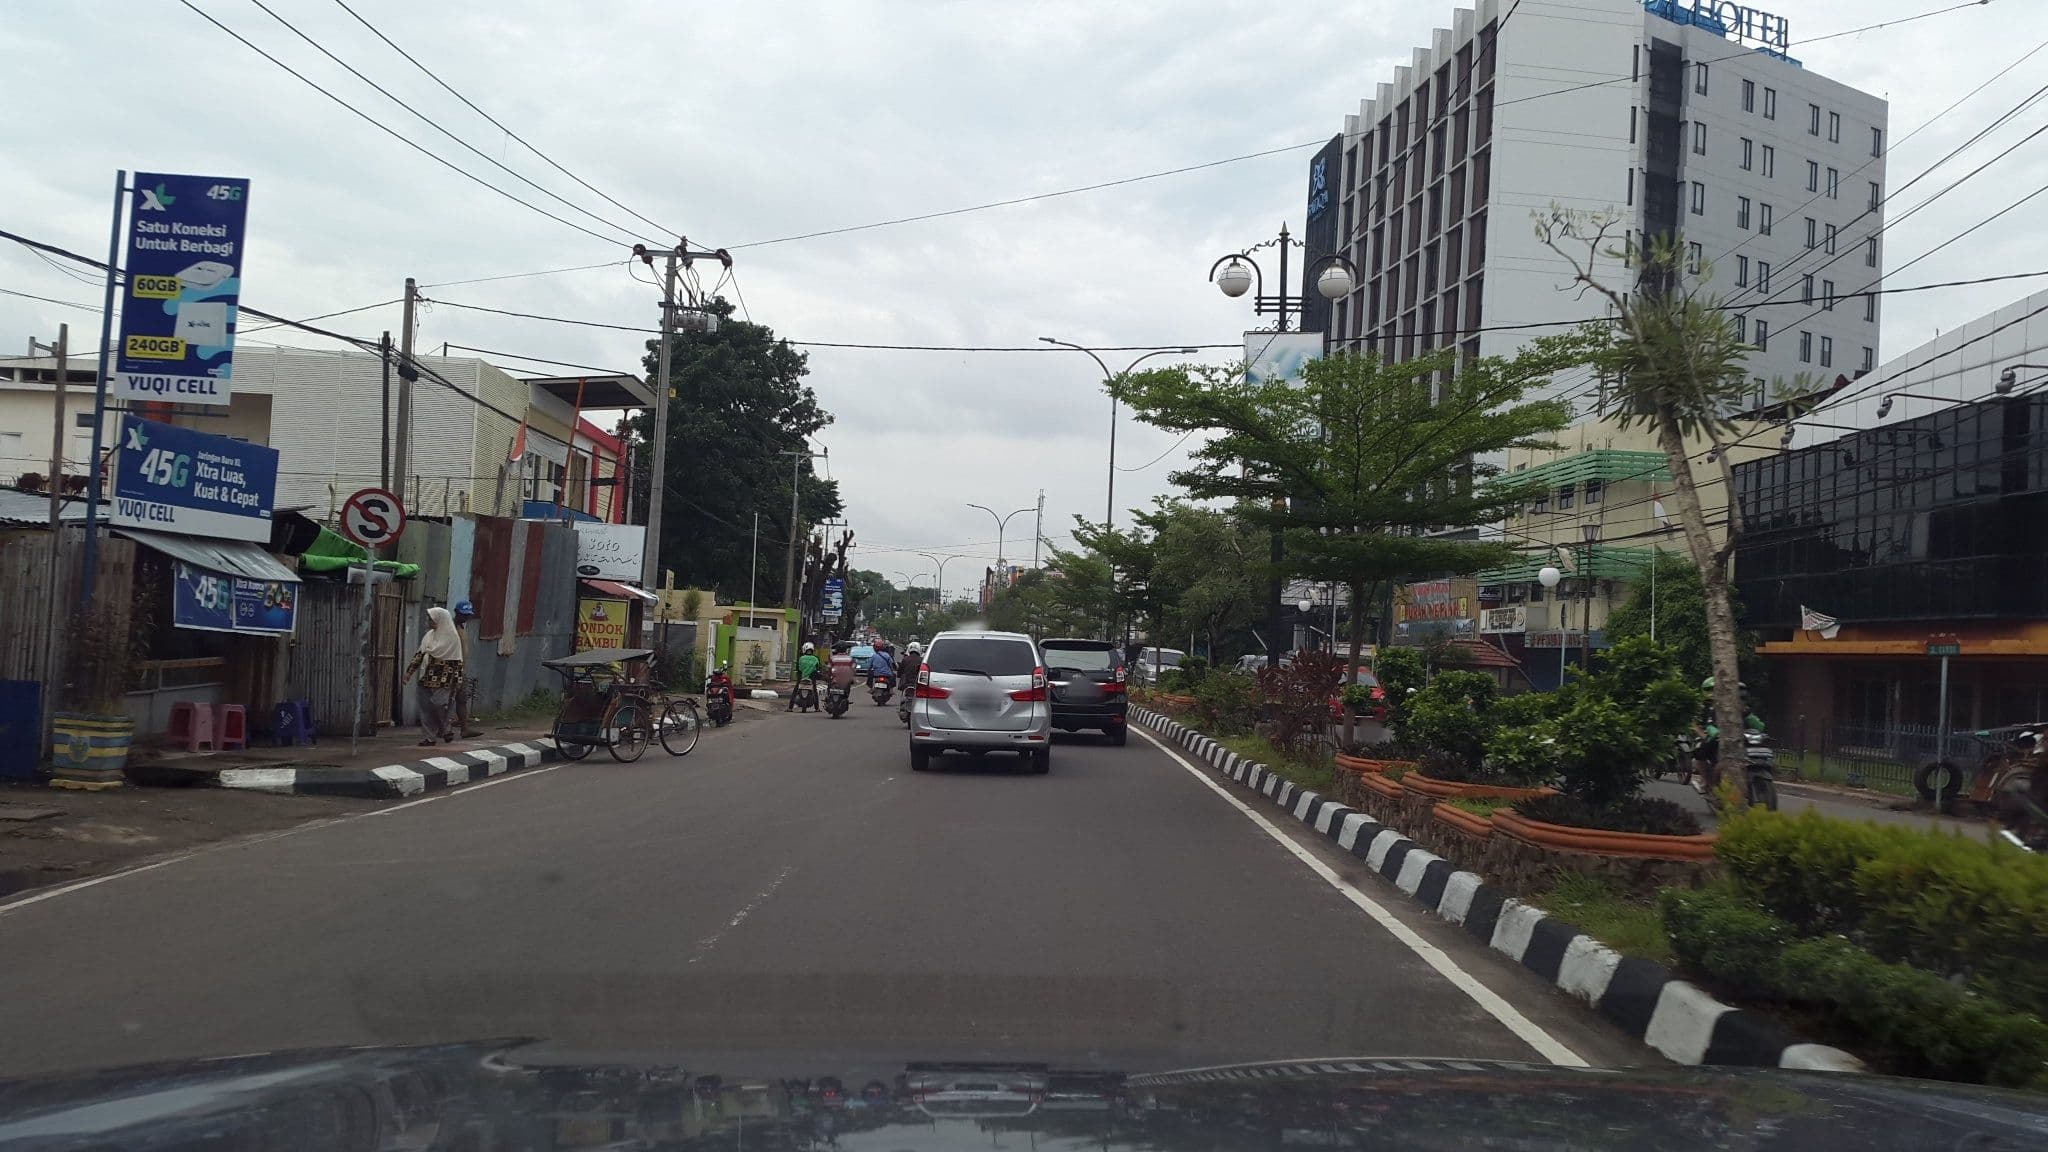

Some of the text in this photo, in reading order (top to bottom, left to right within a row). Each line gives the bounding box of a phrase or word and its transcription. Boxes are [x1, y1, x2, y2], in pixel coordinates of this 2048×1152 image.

[136, 220, 228, 237] Satu Koneksi
[135, 237, 234, 257] Untuk Berbagi
[136, 278, 177, 292] 60GB
[128, 376, 218, 395] YUQI CELL
[195, 462, 247, 488] Xtra Luas,
[194, 482, 260, 508] Kuat & Cepat
[118, 499, 175, 523] YUQI CELL
[358, 499, 389, 539] S
[579, 622, 624, 636] ONDOK
